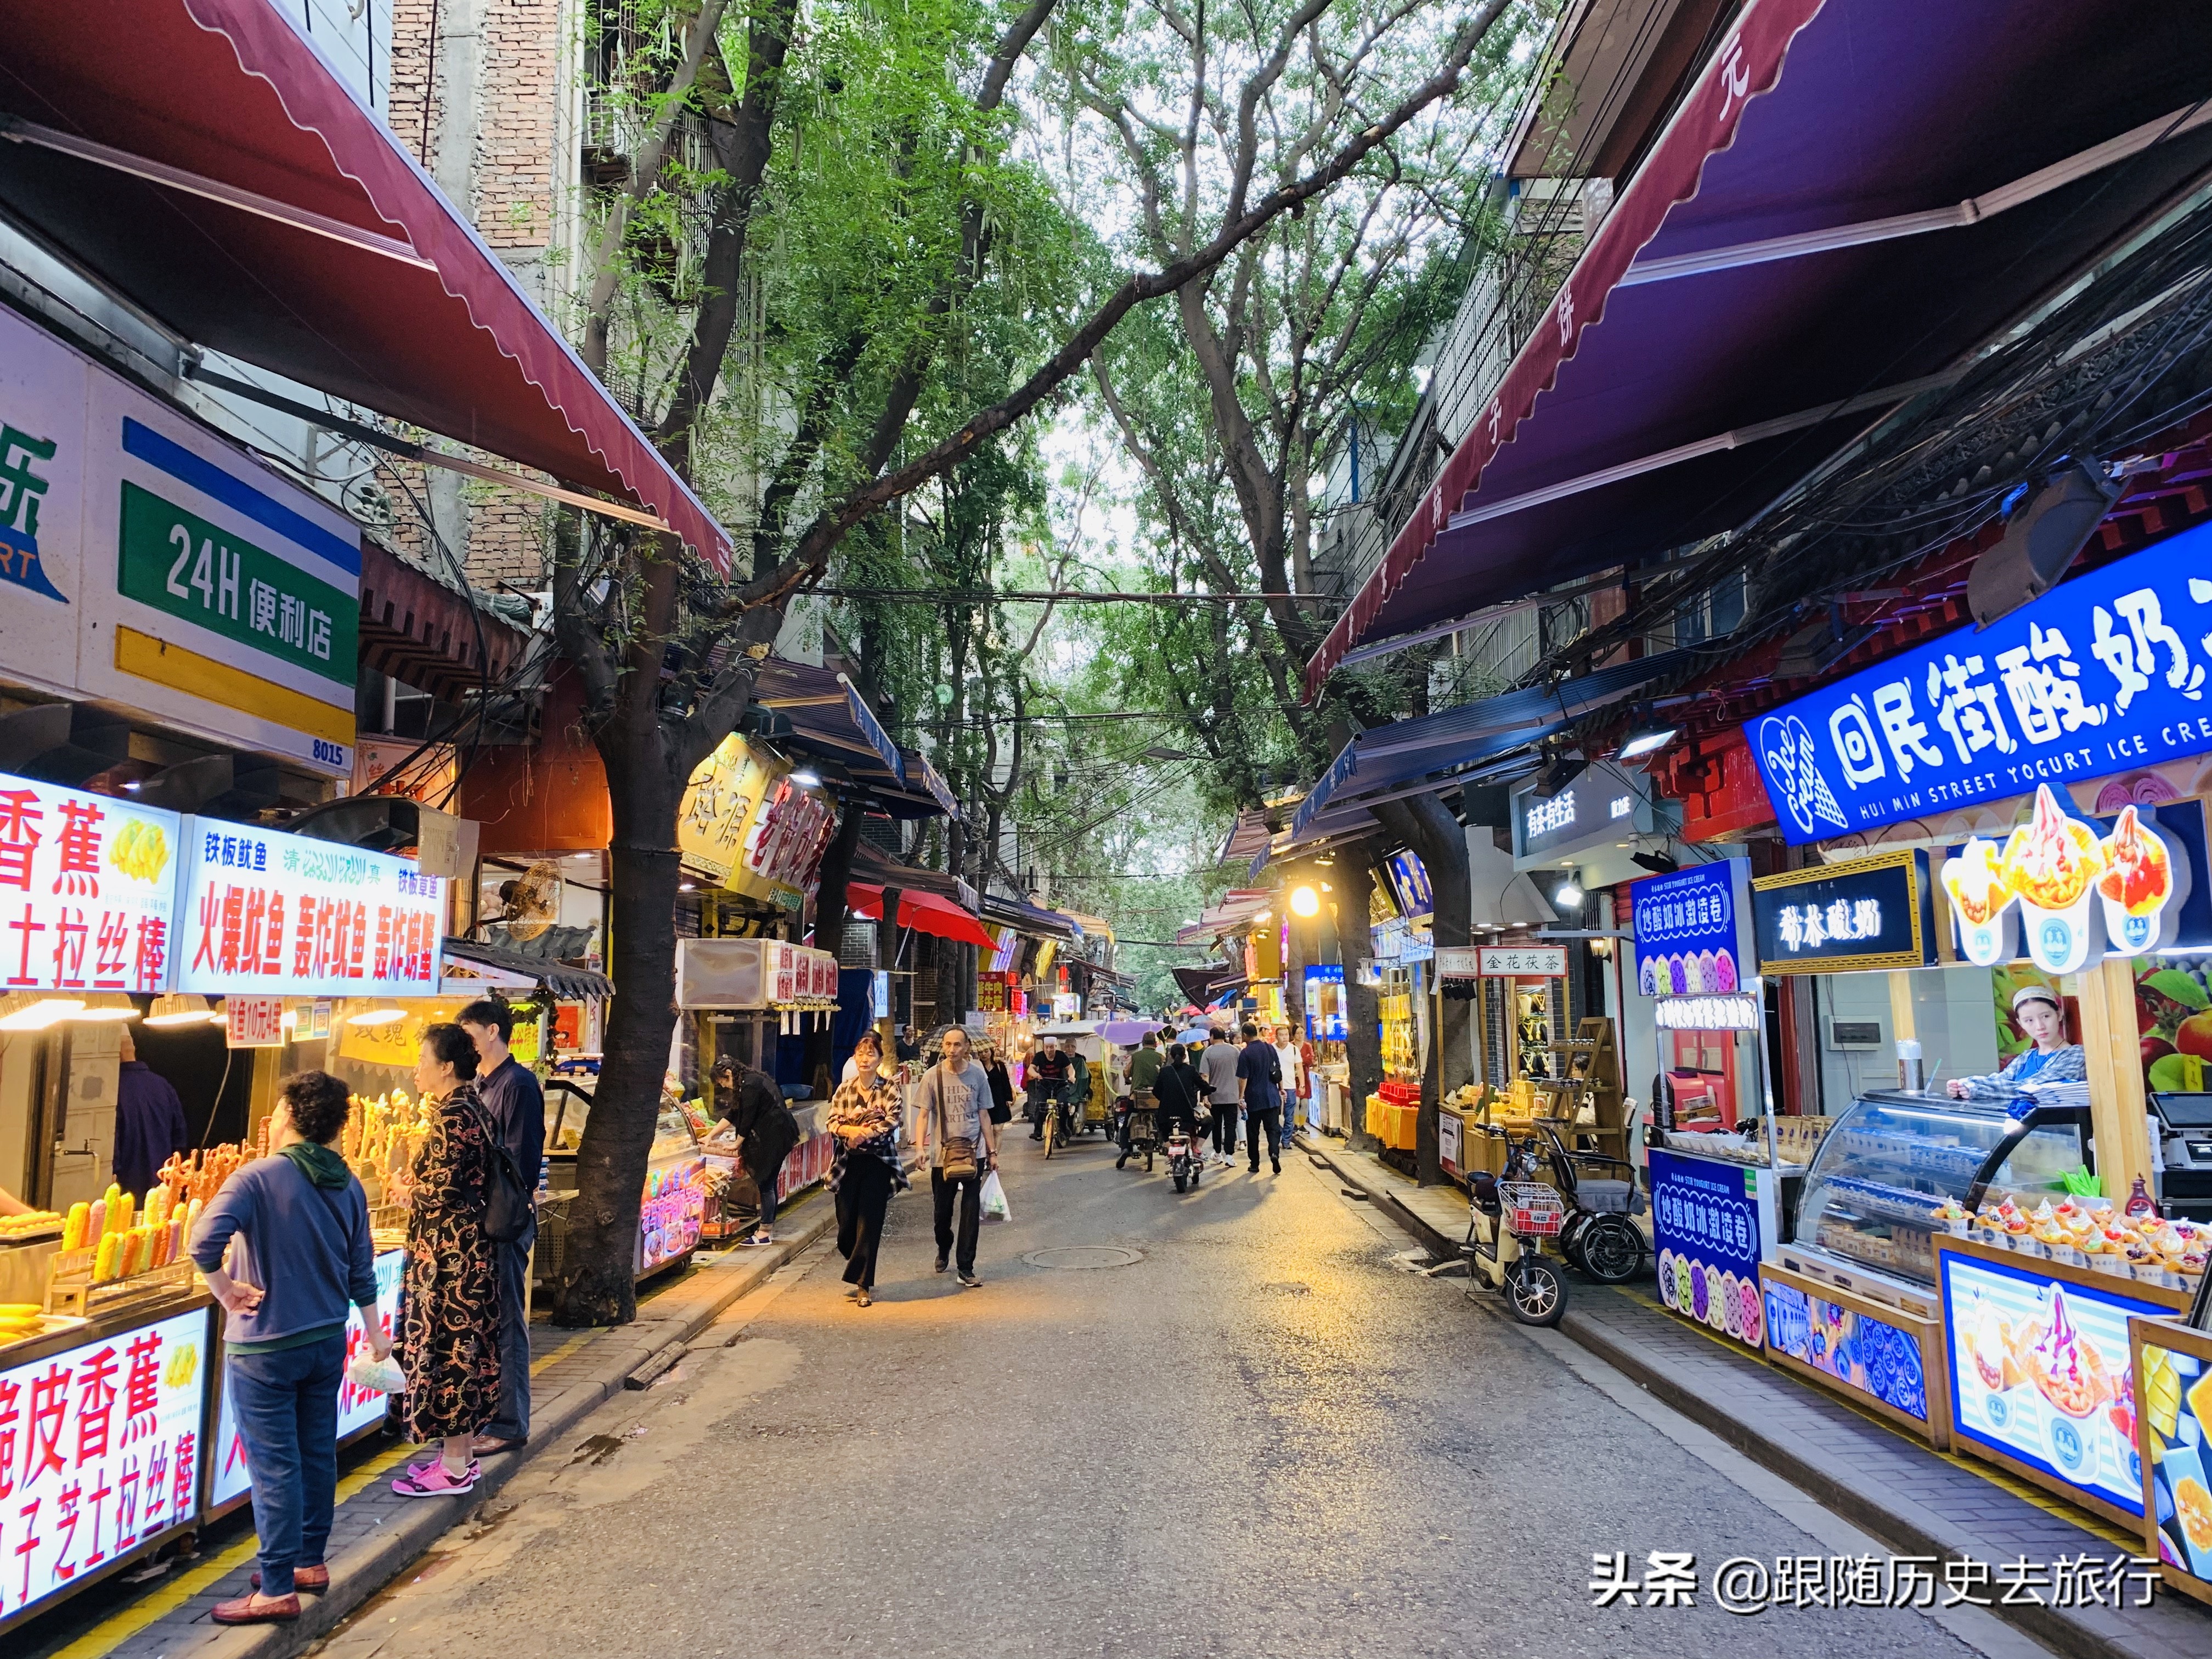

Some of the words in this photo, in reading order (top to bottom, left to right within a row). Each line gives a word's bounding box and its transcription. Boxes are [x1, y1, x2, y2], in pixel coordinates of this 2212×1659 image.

[167, 523, 239, 620] 24H
[249, 578, 332, 660] 便利店
[1829, 577, 2212, 789] 回民街酸奶
[313, 739, 343, 766] 8015
[1859, 801, 1886, 819] HUI
[1892, 792, 1921, 812] MIN
[1931, 776, 1997, 803] STREET
[2007, 748, 2091, 784] YOGURT
[2107, 735, 2148, 760] ICE
[1526, 789, 1576, 839] 有茶有生活
[0, 789, 105, 899] 香蕉
[205, 832, 267, 871] 铁板鱿鱼
[283, 849, 300, 873] 清
[368, 864, 381, 885] 真
[398, 868, 437, 899] 铁板章鱼
[7, 903, 166, 991] 士拉丝棒
[193, 880, 285, 976] 火爆鱿鱼
[292, 894, 366, 981] 轰炸鱿鱼
[373, 904, 436, 982] 轰炸螃蟹
[1486, 954, 1559, 969] 金花茯茶
[228, 997, 281, 1041] 鱿鱼10元4串
[946, 1111, 978, 1123] RTIST
[947, 1094, 972, 1103] LIKE
[0, 1430, 195, 1615] 子芝士拉丝棒
